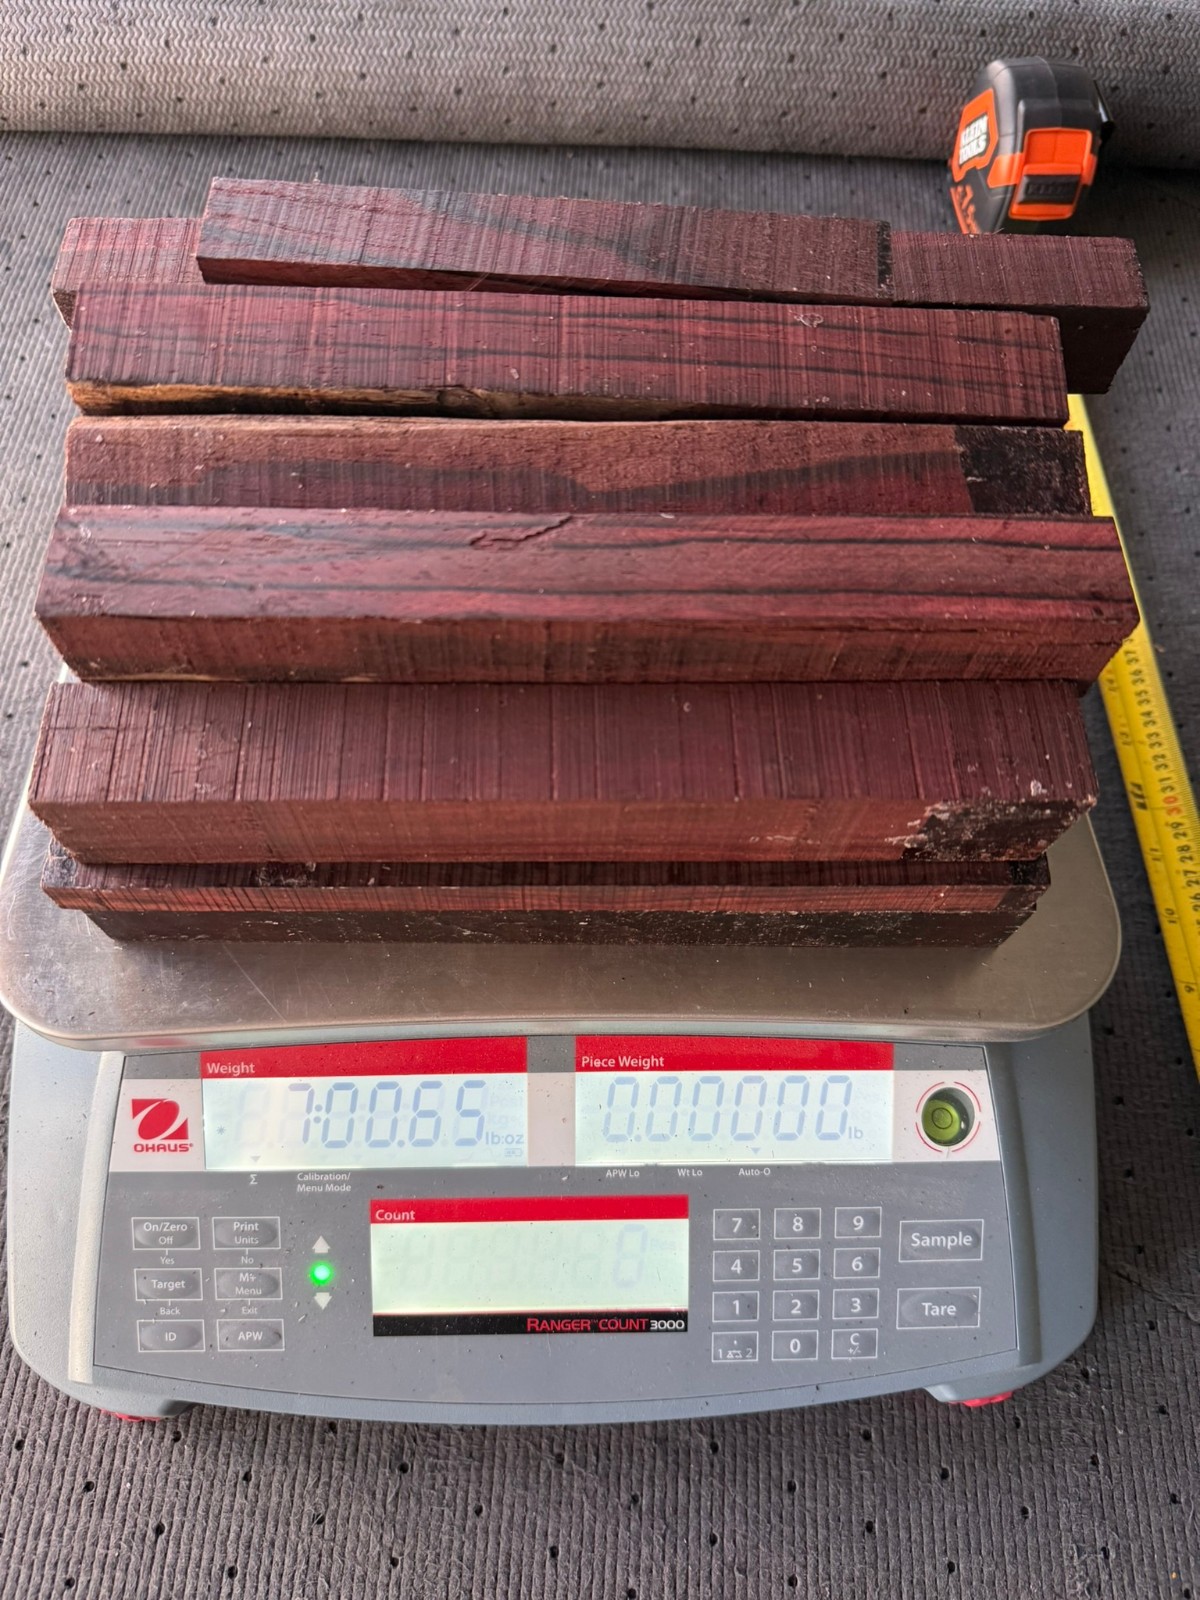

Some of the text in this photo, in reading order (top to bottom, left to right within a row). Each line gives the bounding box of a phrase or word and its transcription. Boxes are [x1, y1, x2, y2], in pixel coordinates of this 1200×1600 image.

[1124, 650, 1139, 665] 37
[1131, 669, 1145, 685] 36
[1135, 689, 1150, 706] 35
[1140, 710, 1156, 728] 34
[1147, 731, 1162, 749] 33
[1152, 753, 1169, 771] 32
[1158, 776, 1175, 793] 31
[1162, 796, 1182, 816] 30
[1170, 821, 1187, 840] 29
[1177, 844, 1194, 863] 28
[1183, 869, 1200, 887] 27
[1165, 908, 1177, 925] 10
[206, 1061, 256, 1076] Weight
[581, 1055, 665, 1069] Piece Weight
[848, 1126, 864, 1141] lb
[133, 1143, 190, 1153] OHAUS
[296, 1172, 351, 1181] Calibration/
[606, 1168, 640, 1177] APW Lo
[677, 1168, 703, 1177] Wt Lo
[296, 1183, 352, 1192] Menu Mode
[376, 1209, 415, 1221] Count
[143, 1221, 188, 1233] On/Zero
[233, 1221, 259, 1232] Print
[732, 1217, 742, 1233] 7
[792, 1216, 803, 1232] 8
[853, 1215, 864, 1231] 9
[158, 1235, 174, 1245] Off
[234, 1235, 260, 1245] Units
[911, 1231, 973, 1250] Sample
[160, 1257, 175, 1265] Yes
[241, 1256, 254, 1265] No
[731, 1258, 742, 1274] 4
[792, 1257, 802, 1273] 5
[852, 1256, 863, 1271] 6
[151, 1279, 186, 1291] Target
[235, 1286, 262, 1295] Menu
[160, 1306, 181, 1315] Back
[241, 1306, 258, 1315] Exit
[733, 1299, 740, 1315] 1
[791, 1299, 801, 1314] 2
[850, 1297, 861, 1312] 3
[921, 1301, 957, 1317] Tare
[598, 1318, 649, 1330] COUNT
[650, 1319, 684, 1330] 3000
[165, 1331, 177, 1341] ID
[238, 1331, 263, 1341] APW
[850, 1332, 860, 1345] C
[789, 1338, 801, 1354] 0
